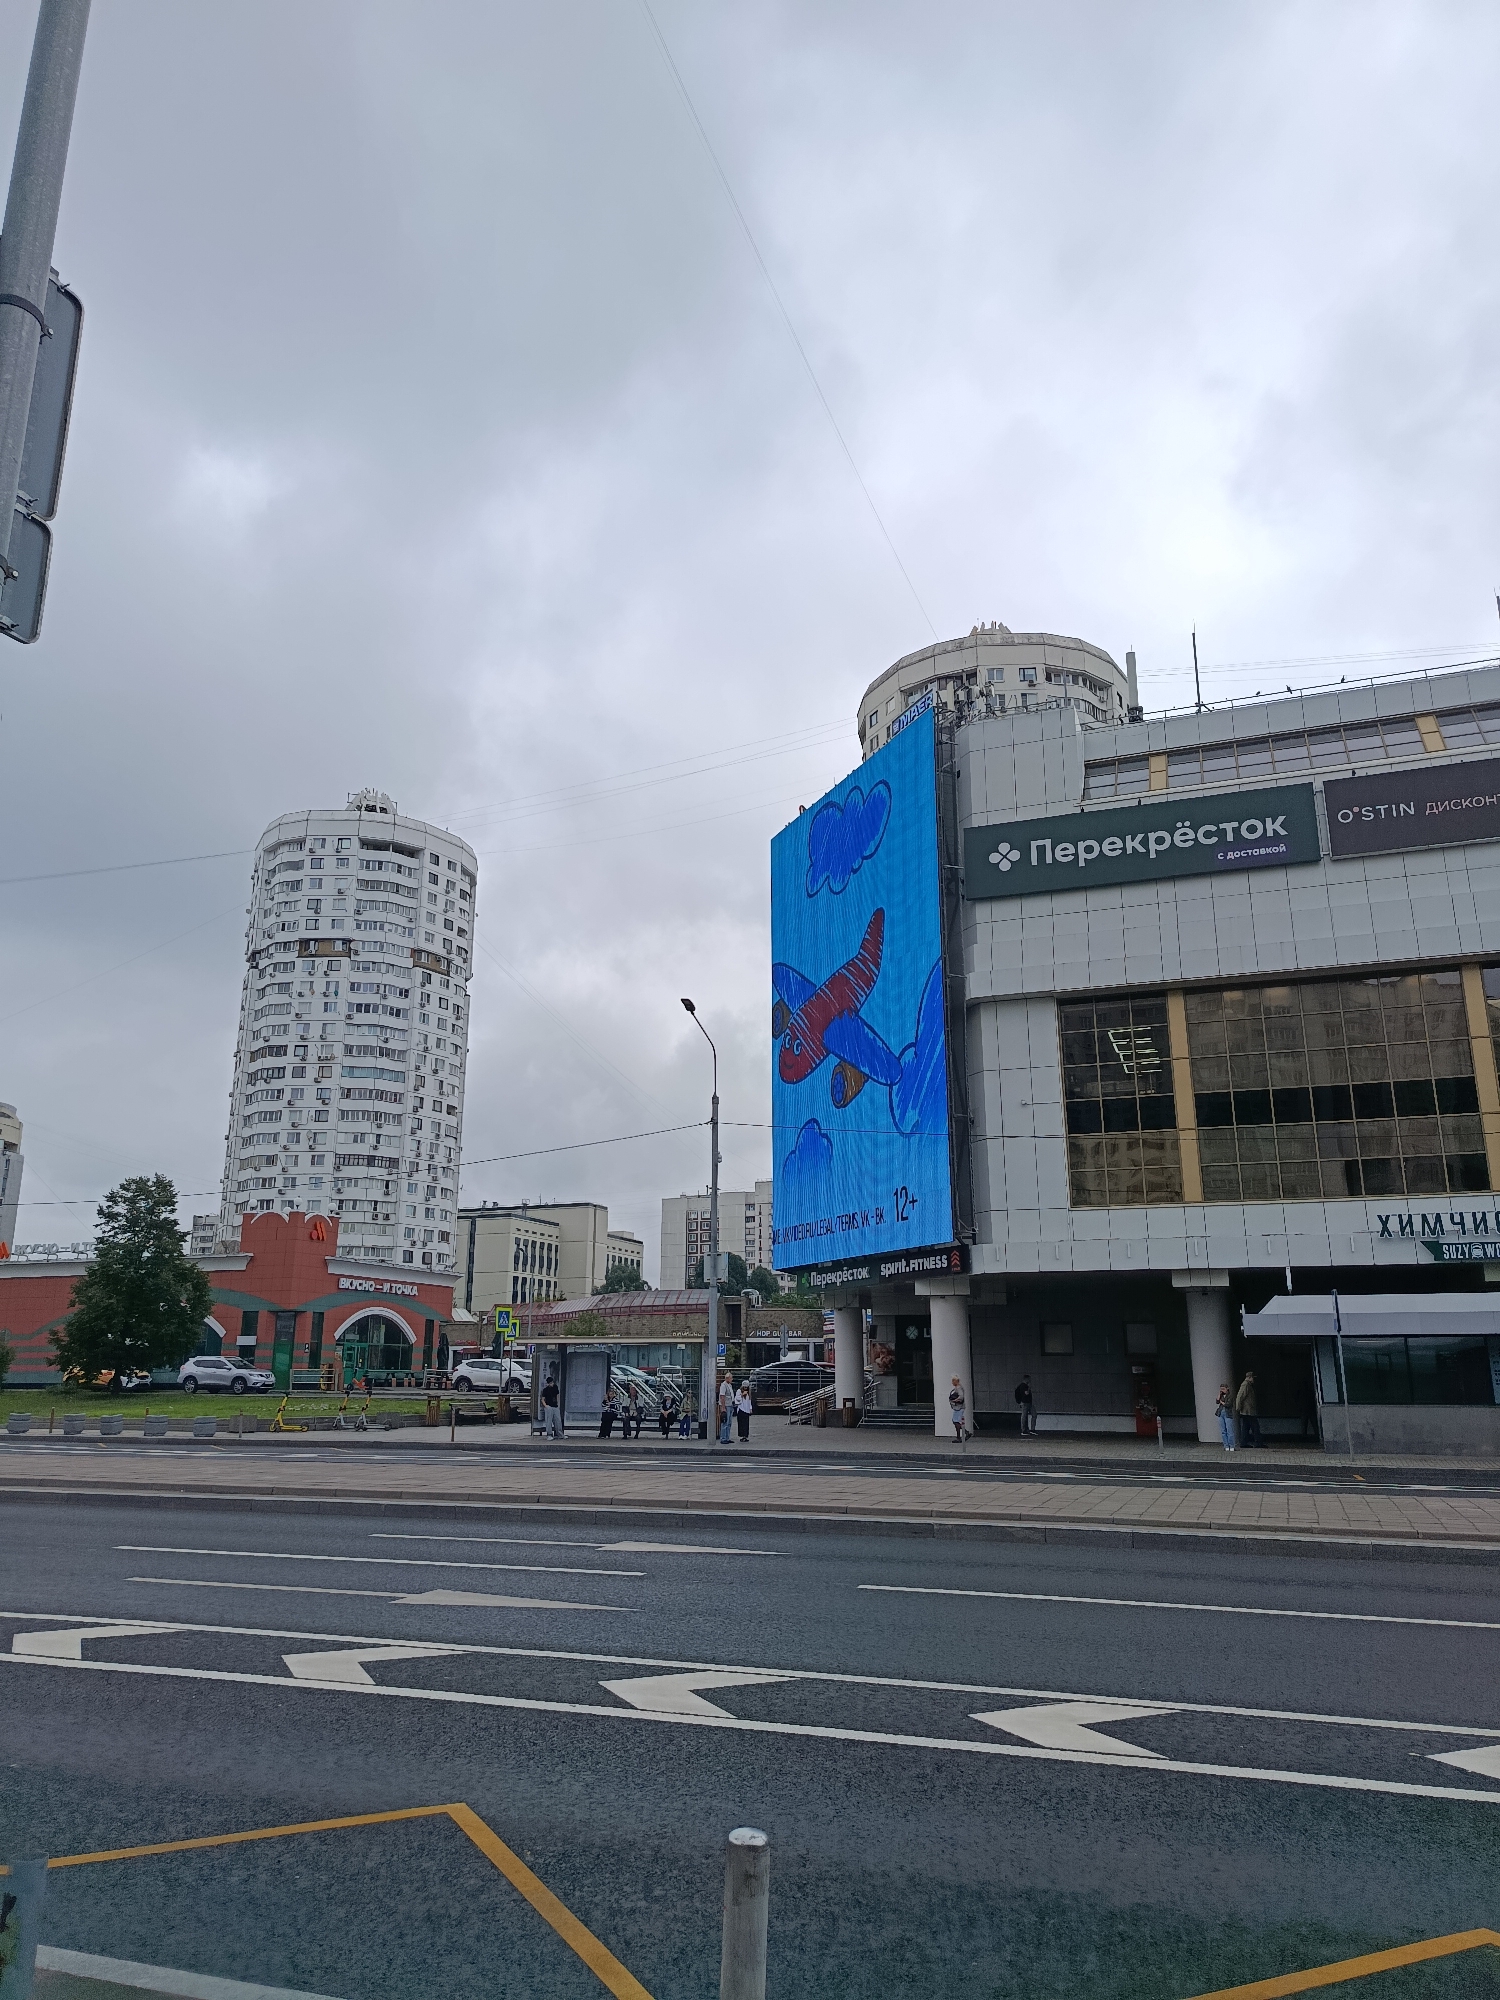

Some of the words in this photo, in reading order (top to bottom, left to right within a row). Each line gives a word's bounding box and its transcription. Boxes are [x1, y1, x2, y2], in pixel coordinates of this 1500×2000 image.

[1426, 793, 1500, 815] ДИСКОН
[1030, 815, 1289, 867] Перекрёсток
[1217, 852, 1225, 860] с
[1226, 843, 1287, 860] доставкой
[893, 1185, 918, 1222] 12+
[14, 1242, 59, 1254] ВКУСНО
[1442, 1243, 1470, 1259] SUZY
[339, 1278, 375, 1292] ВКУСНО
[382, 1282, 391, 1293] И
[391, 1283, 418, 1296] ТОЧКА
[810, 1266, 870, 1288] Перекрёсток
